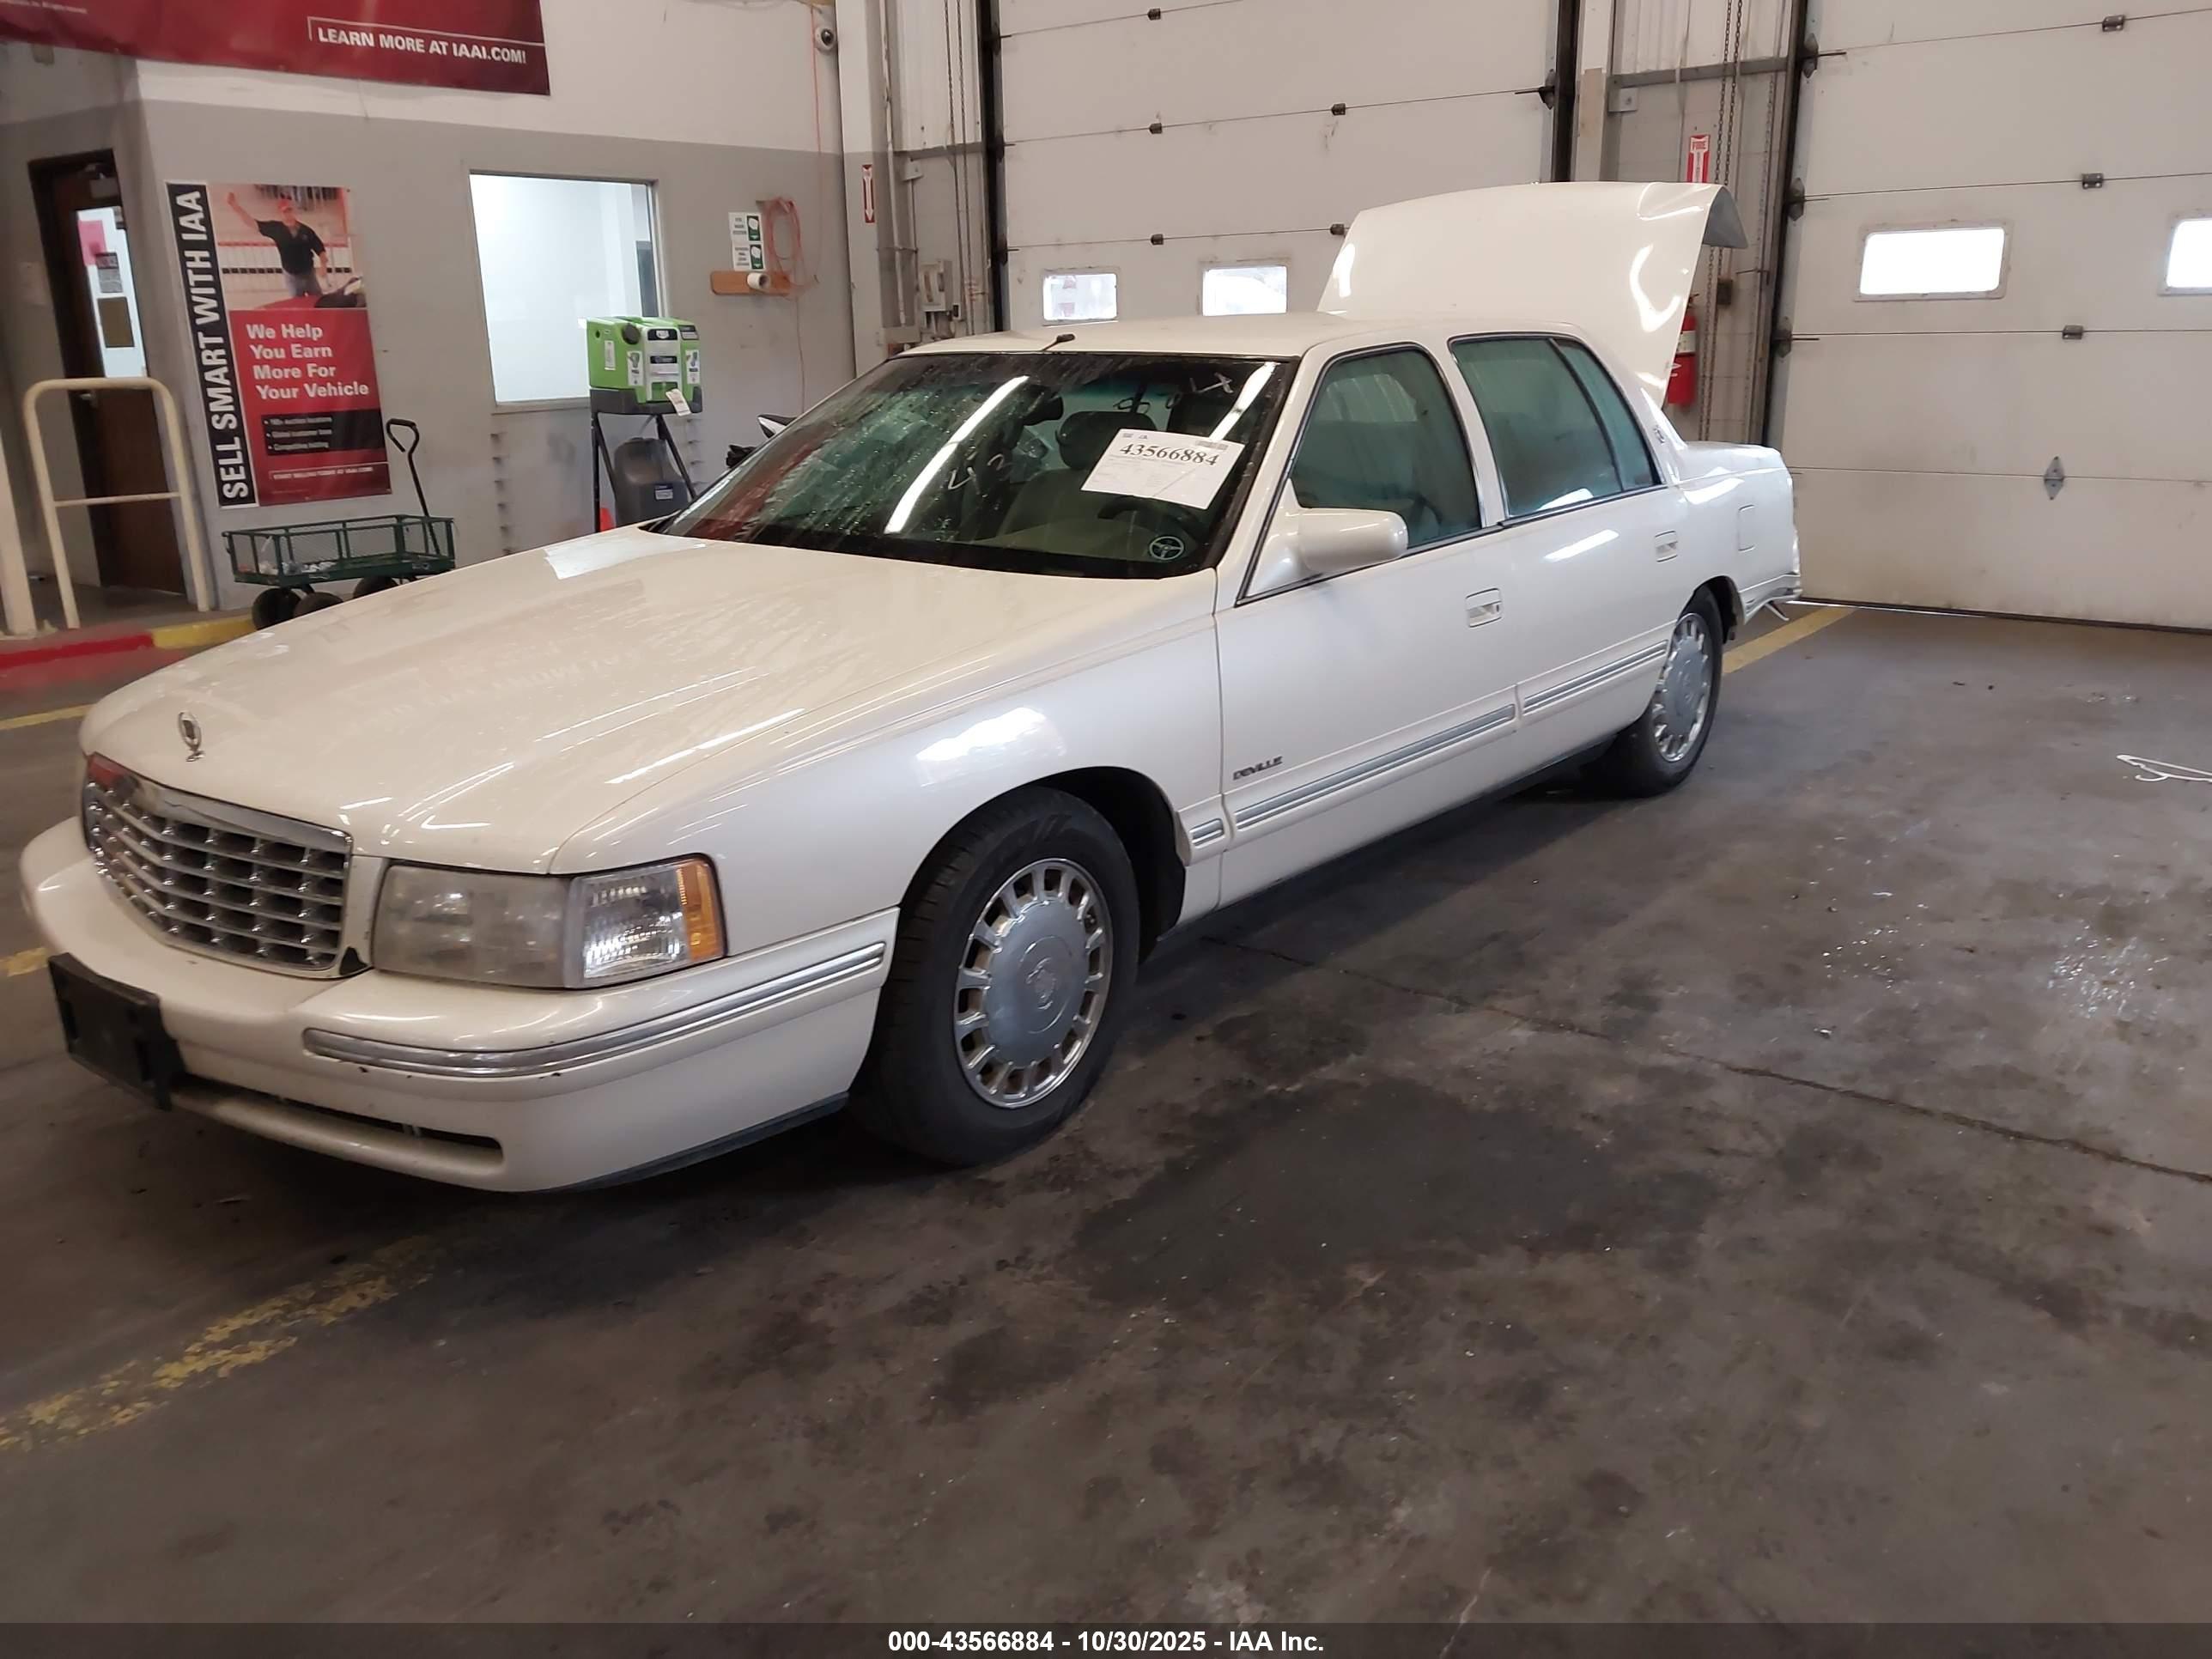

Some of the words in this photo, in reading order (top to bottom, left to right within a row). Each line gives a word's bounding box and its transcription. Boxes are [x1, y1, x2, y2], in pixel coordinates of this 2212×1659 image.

[318, 27, 374, 47] LEARN
[379, 34, 425, 53] MORE
[428, 40, 447, 55] AT
[453, 42, 526, 64] IAAI.COM!
[175, 191, 209, 241] IAA
[185, 252, 220, 326] WITH
[246, 324, 276, 339] We
[281, 323, 323, 341] Help
[249, 344, 286, 359] You
[290, 343, 333, 358] Earn
[198, 331, 239, 431] SMART
[252, 364, 302, 380] More
[306, 363, 336, 378] For
[256, 385, 299, 399] Your
[303, 380, 369, 398] Vehicle
[1119, 443, 1219, 466] 43566884
[216, 436, 249, 499] SELL
[1232, 756, 1284, 781] DEVILLE
